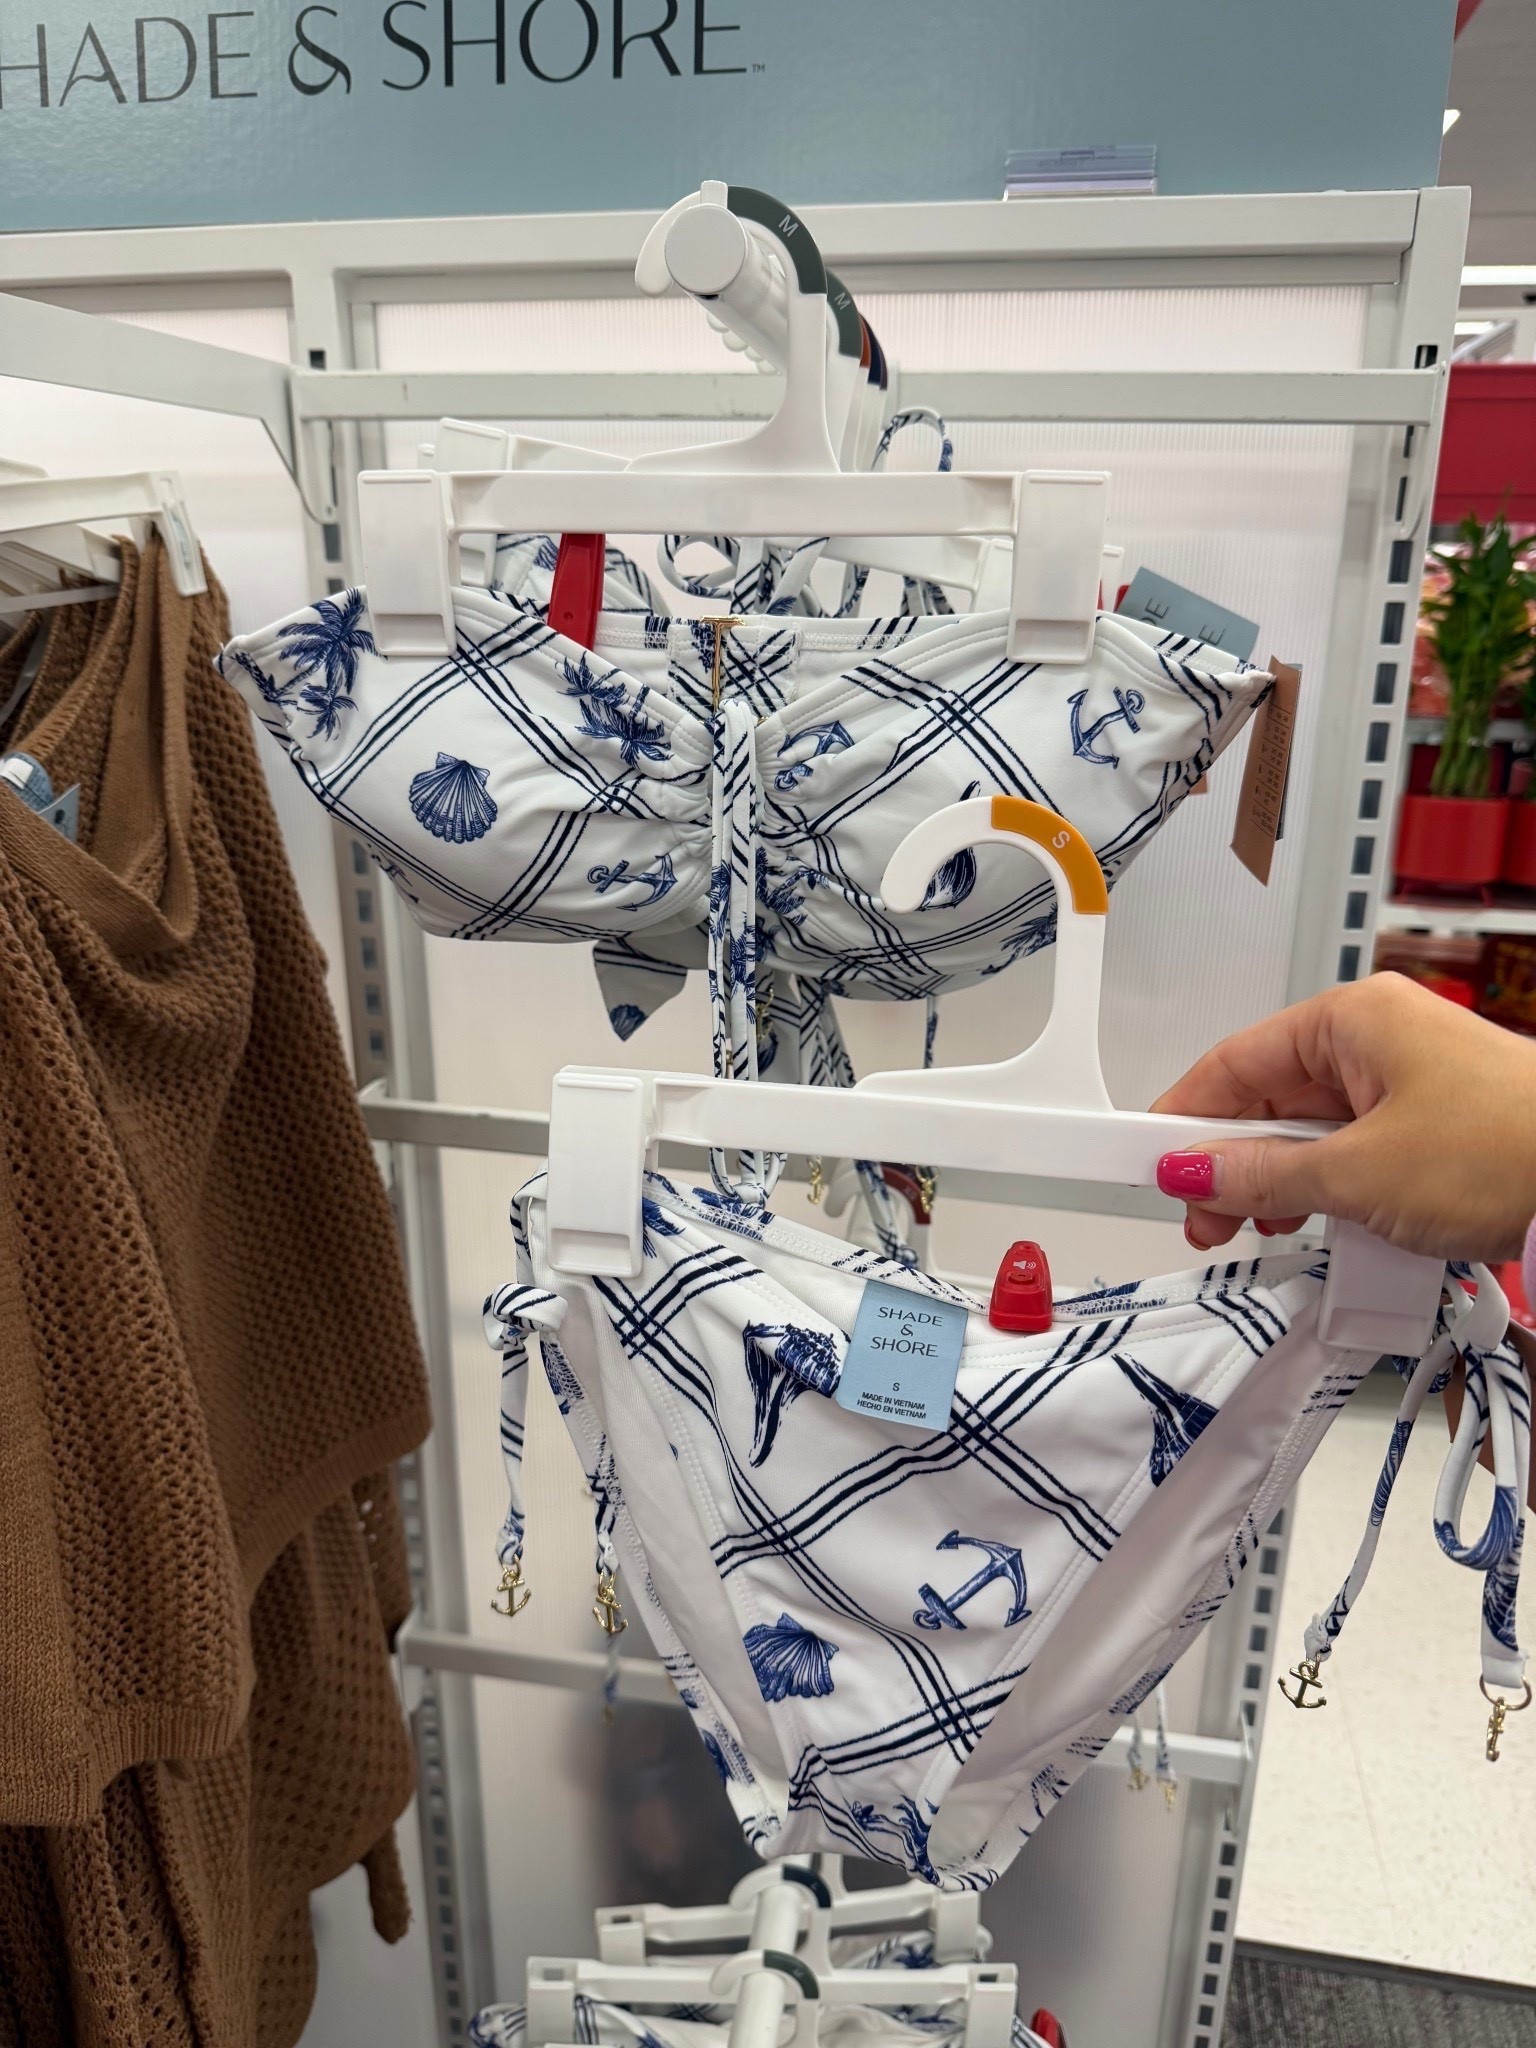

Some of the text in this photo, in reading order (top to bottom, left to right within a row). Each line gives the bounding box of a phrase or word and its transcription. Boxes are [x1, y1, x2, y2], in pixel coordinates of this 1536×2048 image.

[288, 5, 351, 96] &
[381, 0, 747, 90] SHORE
[778, 214, 799, 237] M
[834, 292, 851, 310] M
[1052, 830, 1071, 849] S
[877, 1306, 943, 1327] SHADE
[900, 1323, 914, 1337] &
[870, 1336, 938, 1358] SHORE
[892, 1382, 900, 1392] S
[857, 1399, 927, 1420] HECHO EN VIETNAM
[862, 1392, 925, 1410] MADE IN VIETNAM
